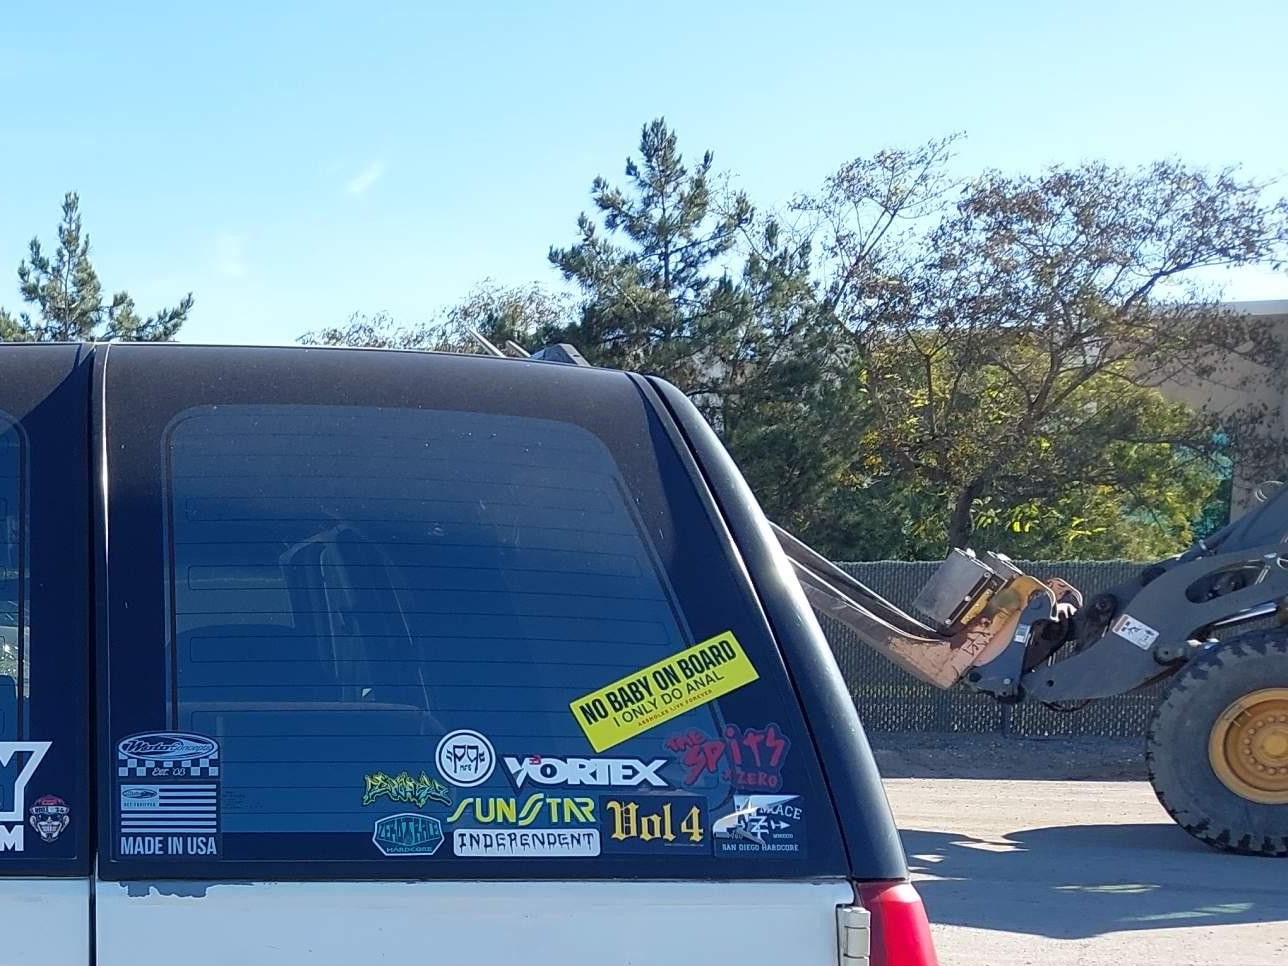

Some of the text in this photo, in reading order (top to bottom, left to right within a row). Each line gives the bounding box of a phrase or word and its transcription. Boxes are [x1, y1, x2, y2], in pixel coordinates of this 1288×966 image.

[579, 639, 737, 726] NO BABY ON BOARD
[613, 670, 725, 727] I ONLY DO ANAL
[606, 801, 704, 842] Vol 4
[120, 836, 217, 855] MADE IN USA
[457, 833, 594, 854] INDEPENDENT
[722, 843, 799, 852] SAN DIEGO HARDCORE
